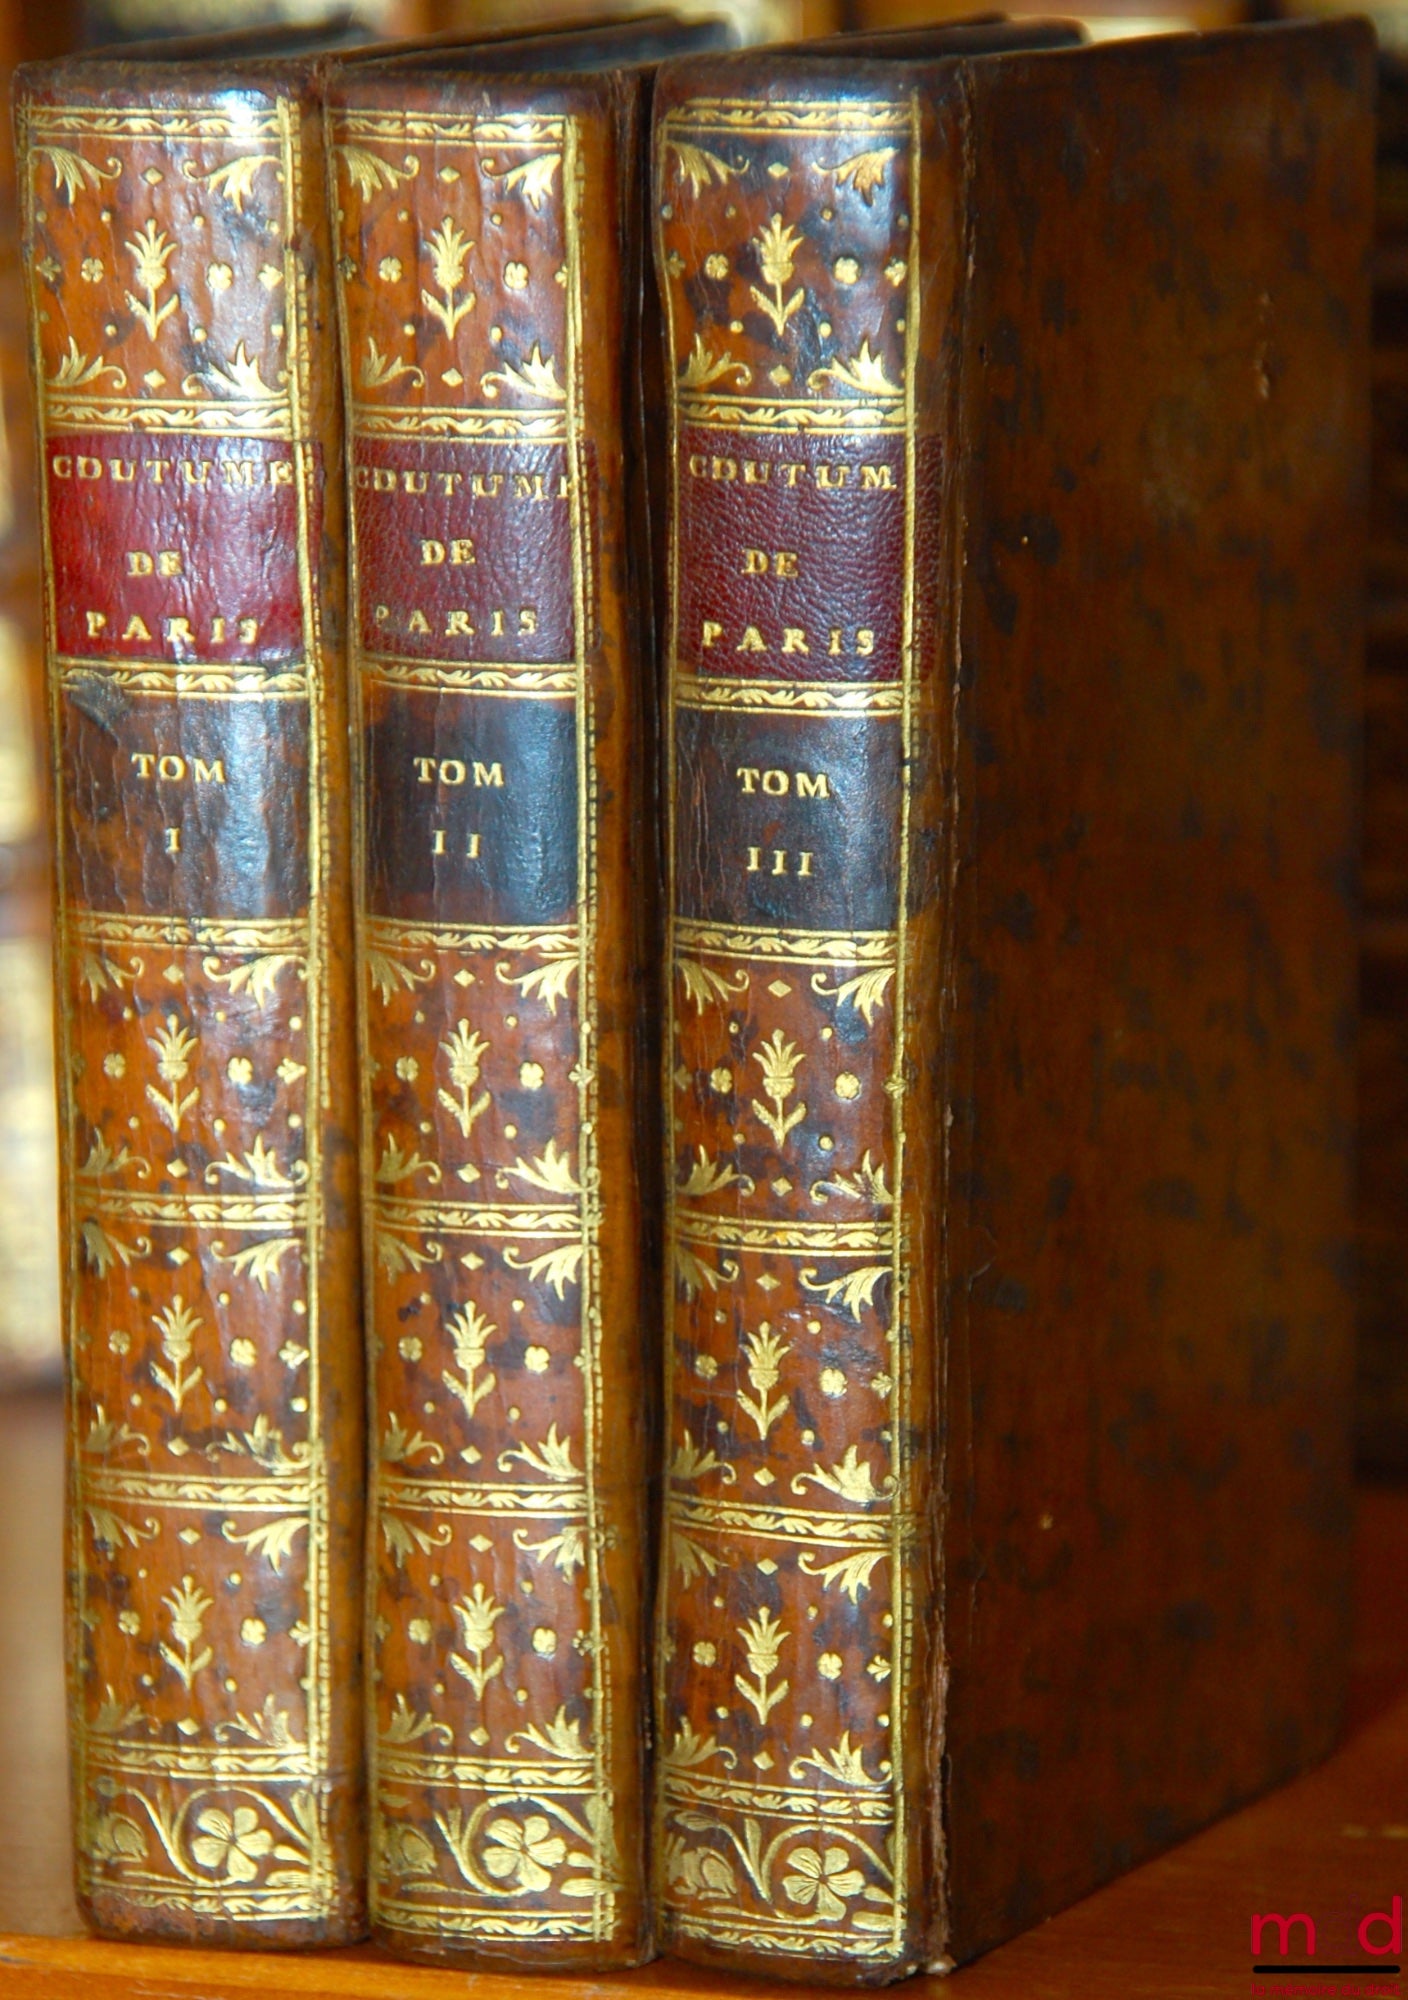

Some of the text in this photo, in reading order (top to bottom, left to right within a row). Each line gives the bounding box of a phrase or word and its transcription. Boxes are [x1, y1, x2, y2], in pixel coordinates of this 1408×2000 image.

[127, 551, 183, 577] DE
[421, 538, 476, 566] DE
[741, 549, 799, 578] DE
[86, 610, 259, 645] PARIS
[375, 604, 538, 637] PARIS
[702, 621, 876, 656] PARIS
[131, 752, 226, 784] TOM
[413, 757, 505, 788] TOM
[736, 767, 831, 799] TOM
[164, 827, 182, 854] I
[746, 846, 814, 877] III
